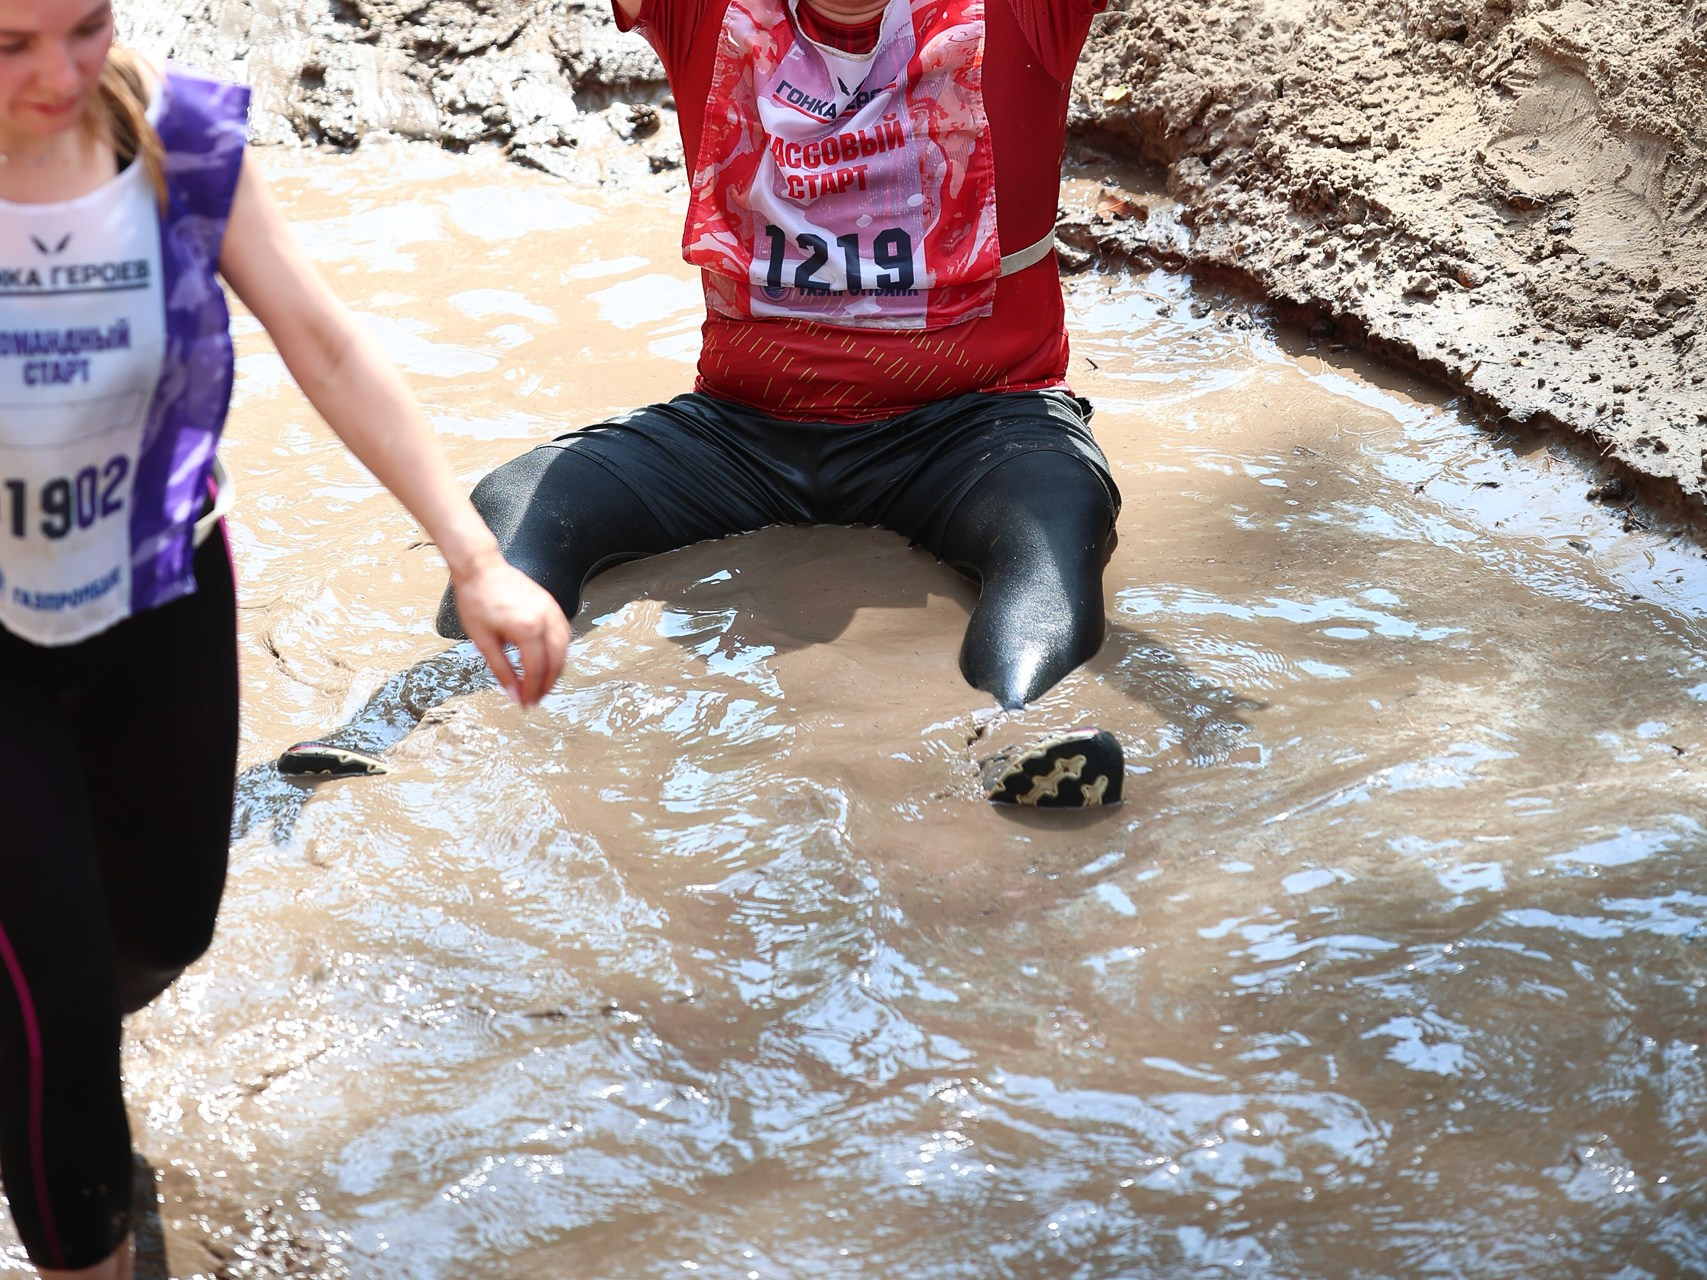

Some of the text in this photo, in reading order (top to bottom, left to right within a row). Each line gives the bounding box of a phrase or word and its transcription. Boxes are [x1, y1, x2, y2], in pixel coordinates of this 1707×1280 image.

[776, 80, 837, 120] ГОНКА
[766, 113, 906, 170] АССОВЫЙ
[787, 164, 868, 199] СТАРТ
[51, 260, 149, 285] ГЕРОЕВ
[766, 224, 914, 290] 1219
[24, 358, 90, 385] СТАРТ
[5, 454, 130, 540] 1902
